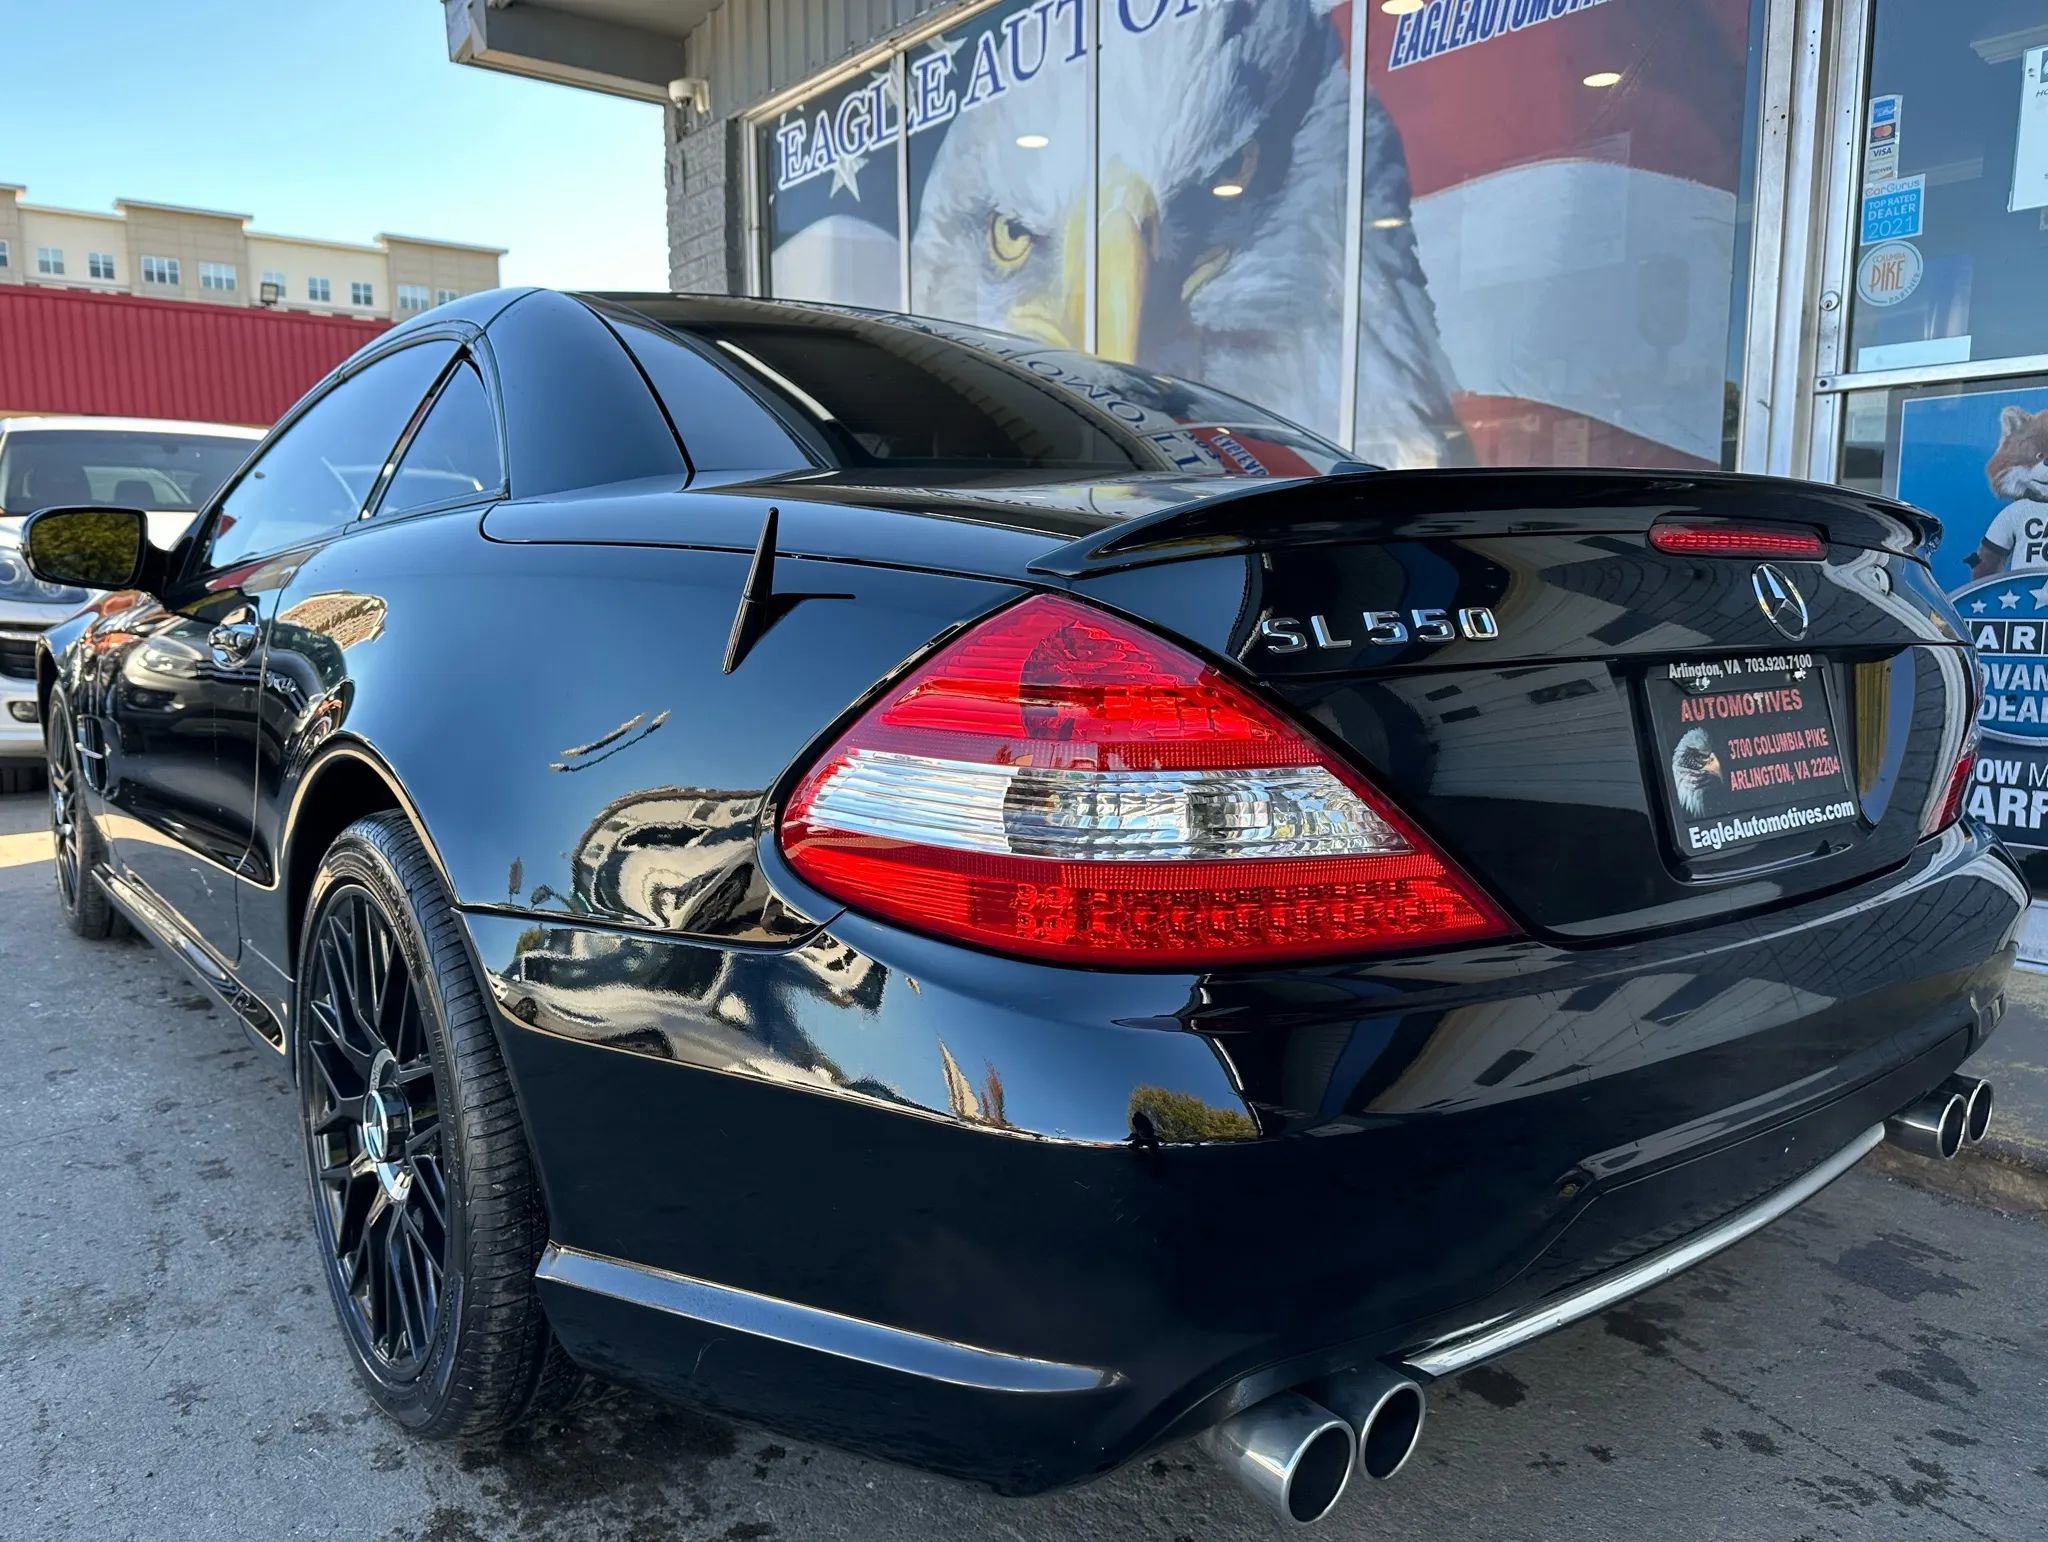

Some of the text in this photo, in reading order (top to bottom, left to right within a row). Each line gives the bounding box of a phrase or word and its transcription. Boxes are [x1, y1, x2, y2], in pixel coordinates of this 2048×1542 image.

[778, 50, 955, 189] EAGLE
[1873, 147, 1892, 157] VISA
[1866, 180, 1920, 197] CarGurus
[1869, 193, 1917, 210] TOP RATED
[1868, 203, 1917, 221] DEALER
[1868, 216, 1915, 239] 2021
[1869, 260, 1906, 293] PIKE
[1261, 607, 1499, 654] SL 550
[1669, 654, 1813, 679] Arlington, VA 703.920.7100
[1680, 688, 1804, 722] AUTOMOTIVES
[1728, 727, 1829, 760] 3700 COLUMBIA PIKE
[1730, 755, 1841, 791] ARLINGTON, VA 22204
[1688, 800, 1856, 850] EagleAutomotives.com
